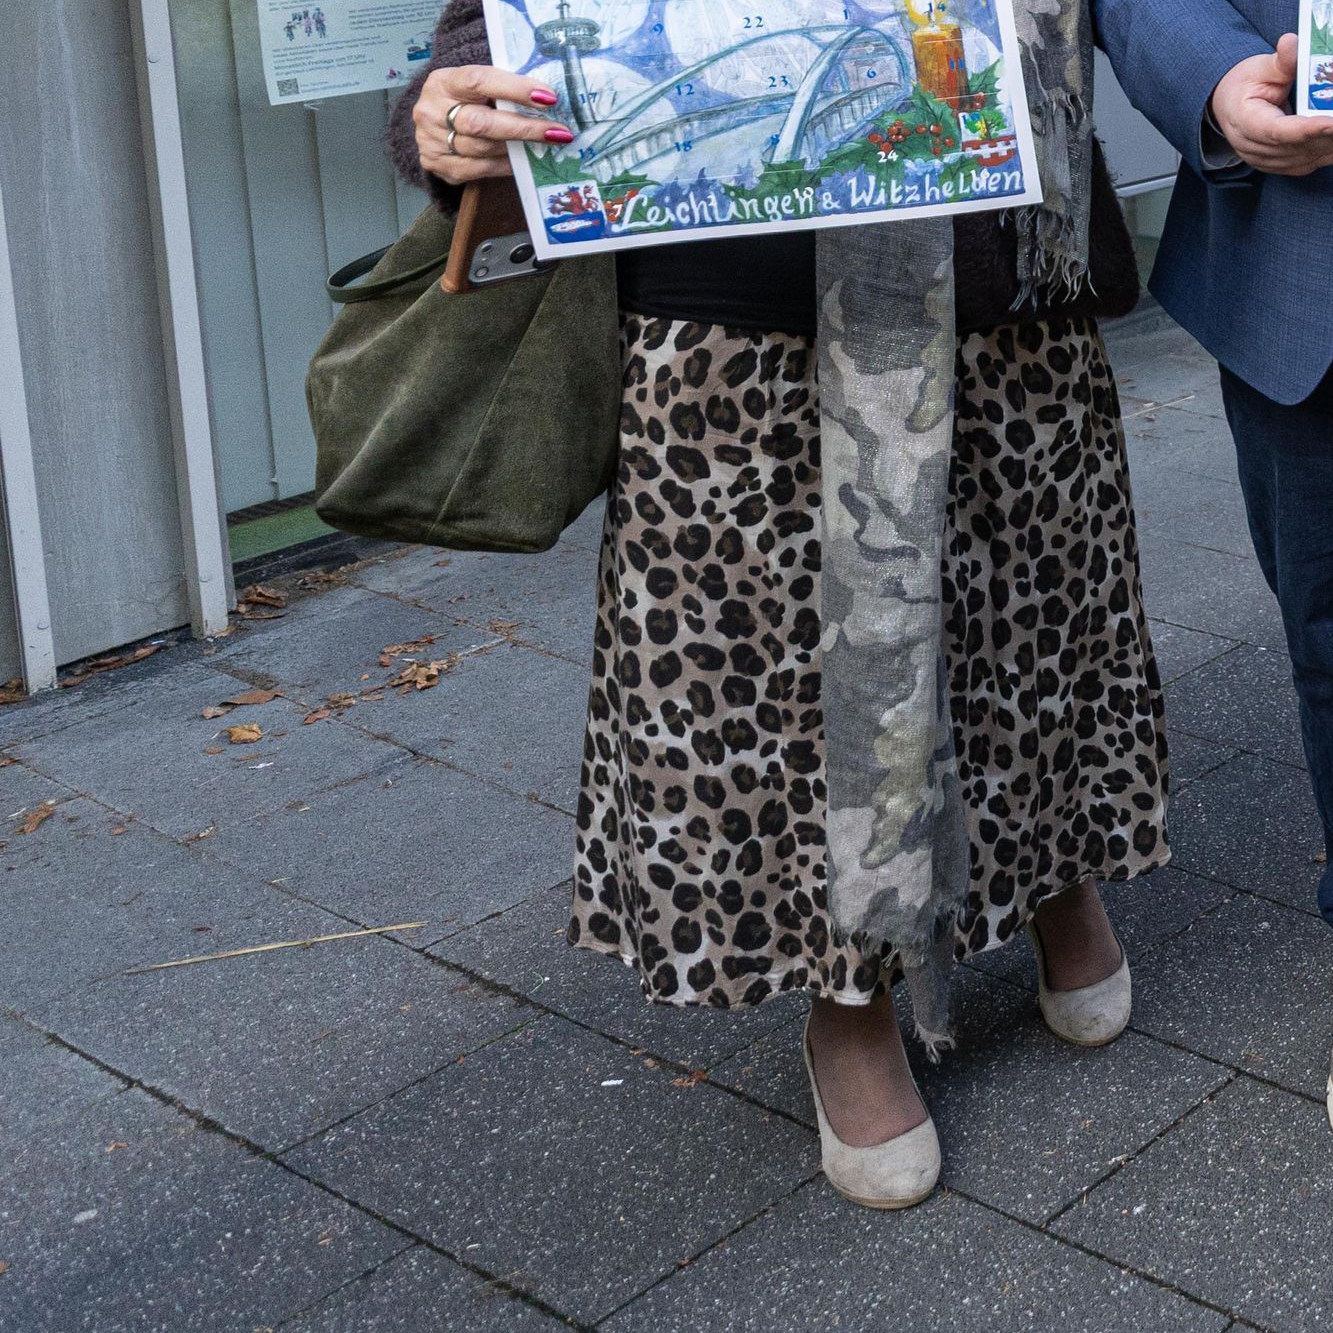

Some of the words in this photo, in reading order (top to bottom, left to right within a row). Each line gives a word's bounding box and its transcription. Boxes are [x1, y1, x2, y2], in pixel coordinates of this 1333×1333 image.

[927, 1, 947, 12] 14
[743, 17, 763, 29] 22
[768, 75, 790, 87] 23
[677, 83, 695, 95] 12
[674, 141, 693, 152] 18
[876, 149, 899, 163] 24
[820, 190, 841, 210] &
